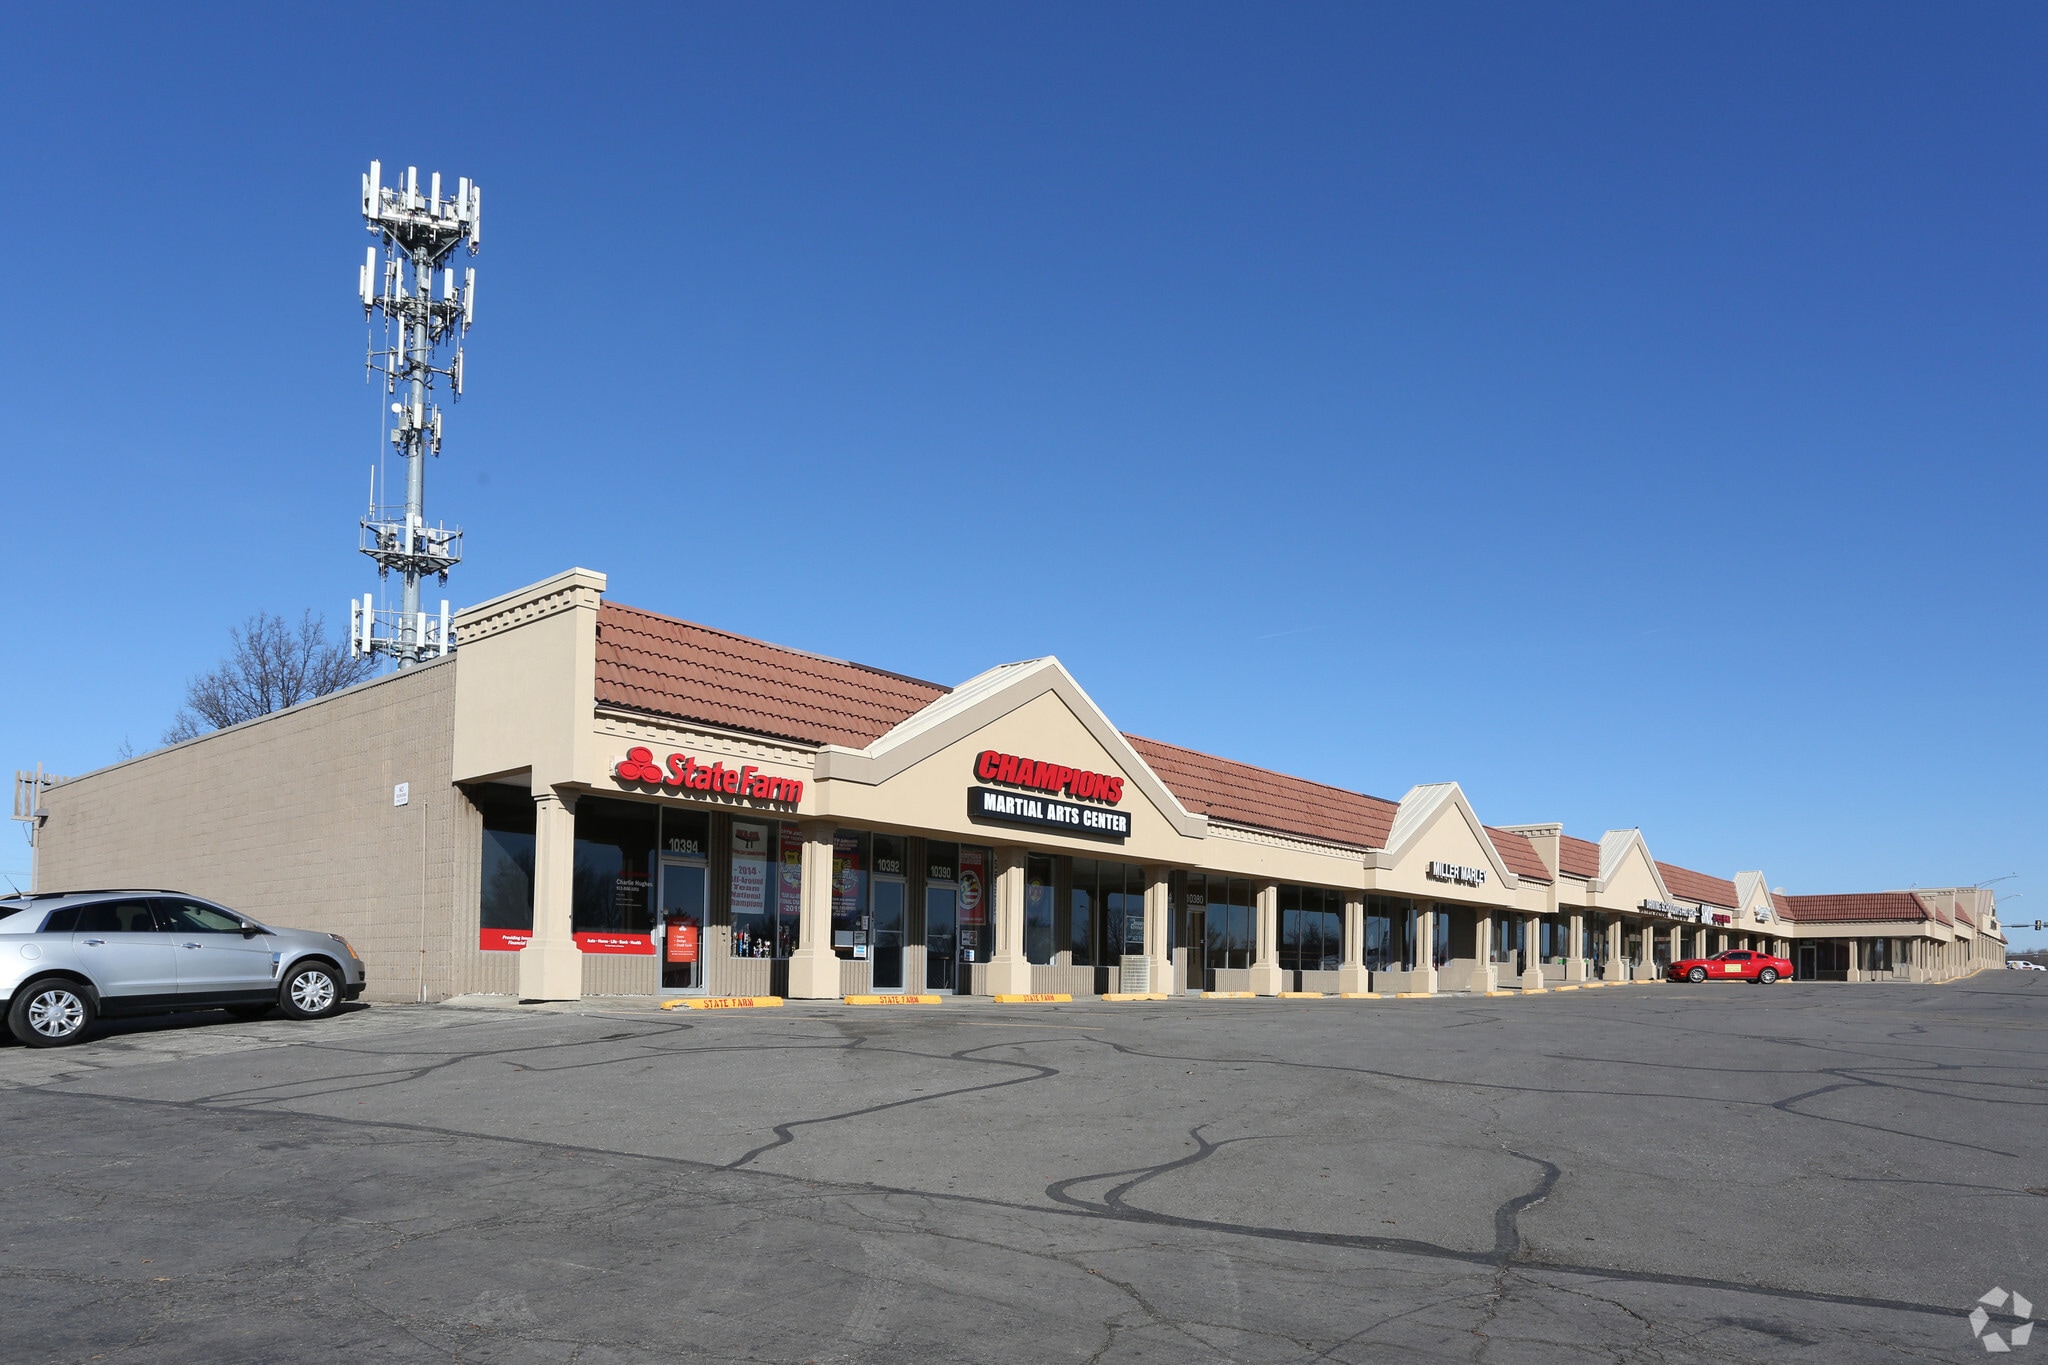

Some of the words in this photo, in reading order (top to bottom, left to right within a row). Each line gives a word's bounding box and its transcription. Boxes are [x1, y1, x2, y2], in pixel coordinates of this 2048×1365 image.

[977, 750, 1125, 803] CHAMPIONS
[984, 792, 1043, 819] MARTIAL
[1046, 803, 1080, 825] ARTS
[1083, 809, 1127, 832] CENTER
[669, 838, 698, 854] 10394
[877, 859, 900, 873] 10392
[930, 865, 952, 879] 10390
[1432, 861, 1459, 879] MILLER
[1460, 866, 1487, 884] MARLEY
[616, 878, 634, 886] Charlie
[732, 884, 760, 892] Team
[703, 999, 729, 1009] STATE
[732, 998, 754, 1008] FARM
[880, 995, 900, 1004] STATE
[901, 995, 920, 1004] FARM
[1023, 994, 1040, 1002] STATE
[1041, 994, 1055, 1002] FARM
